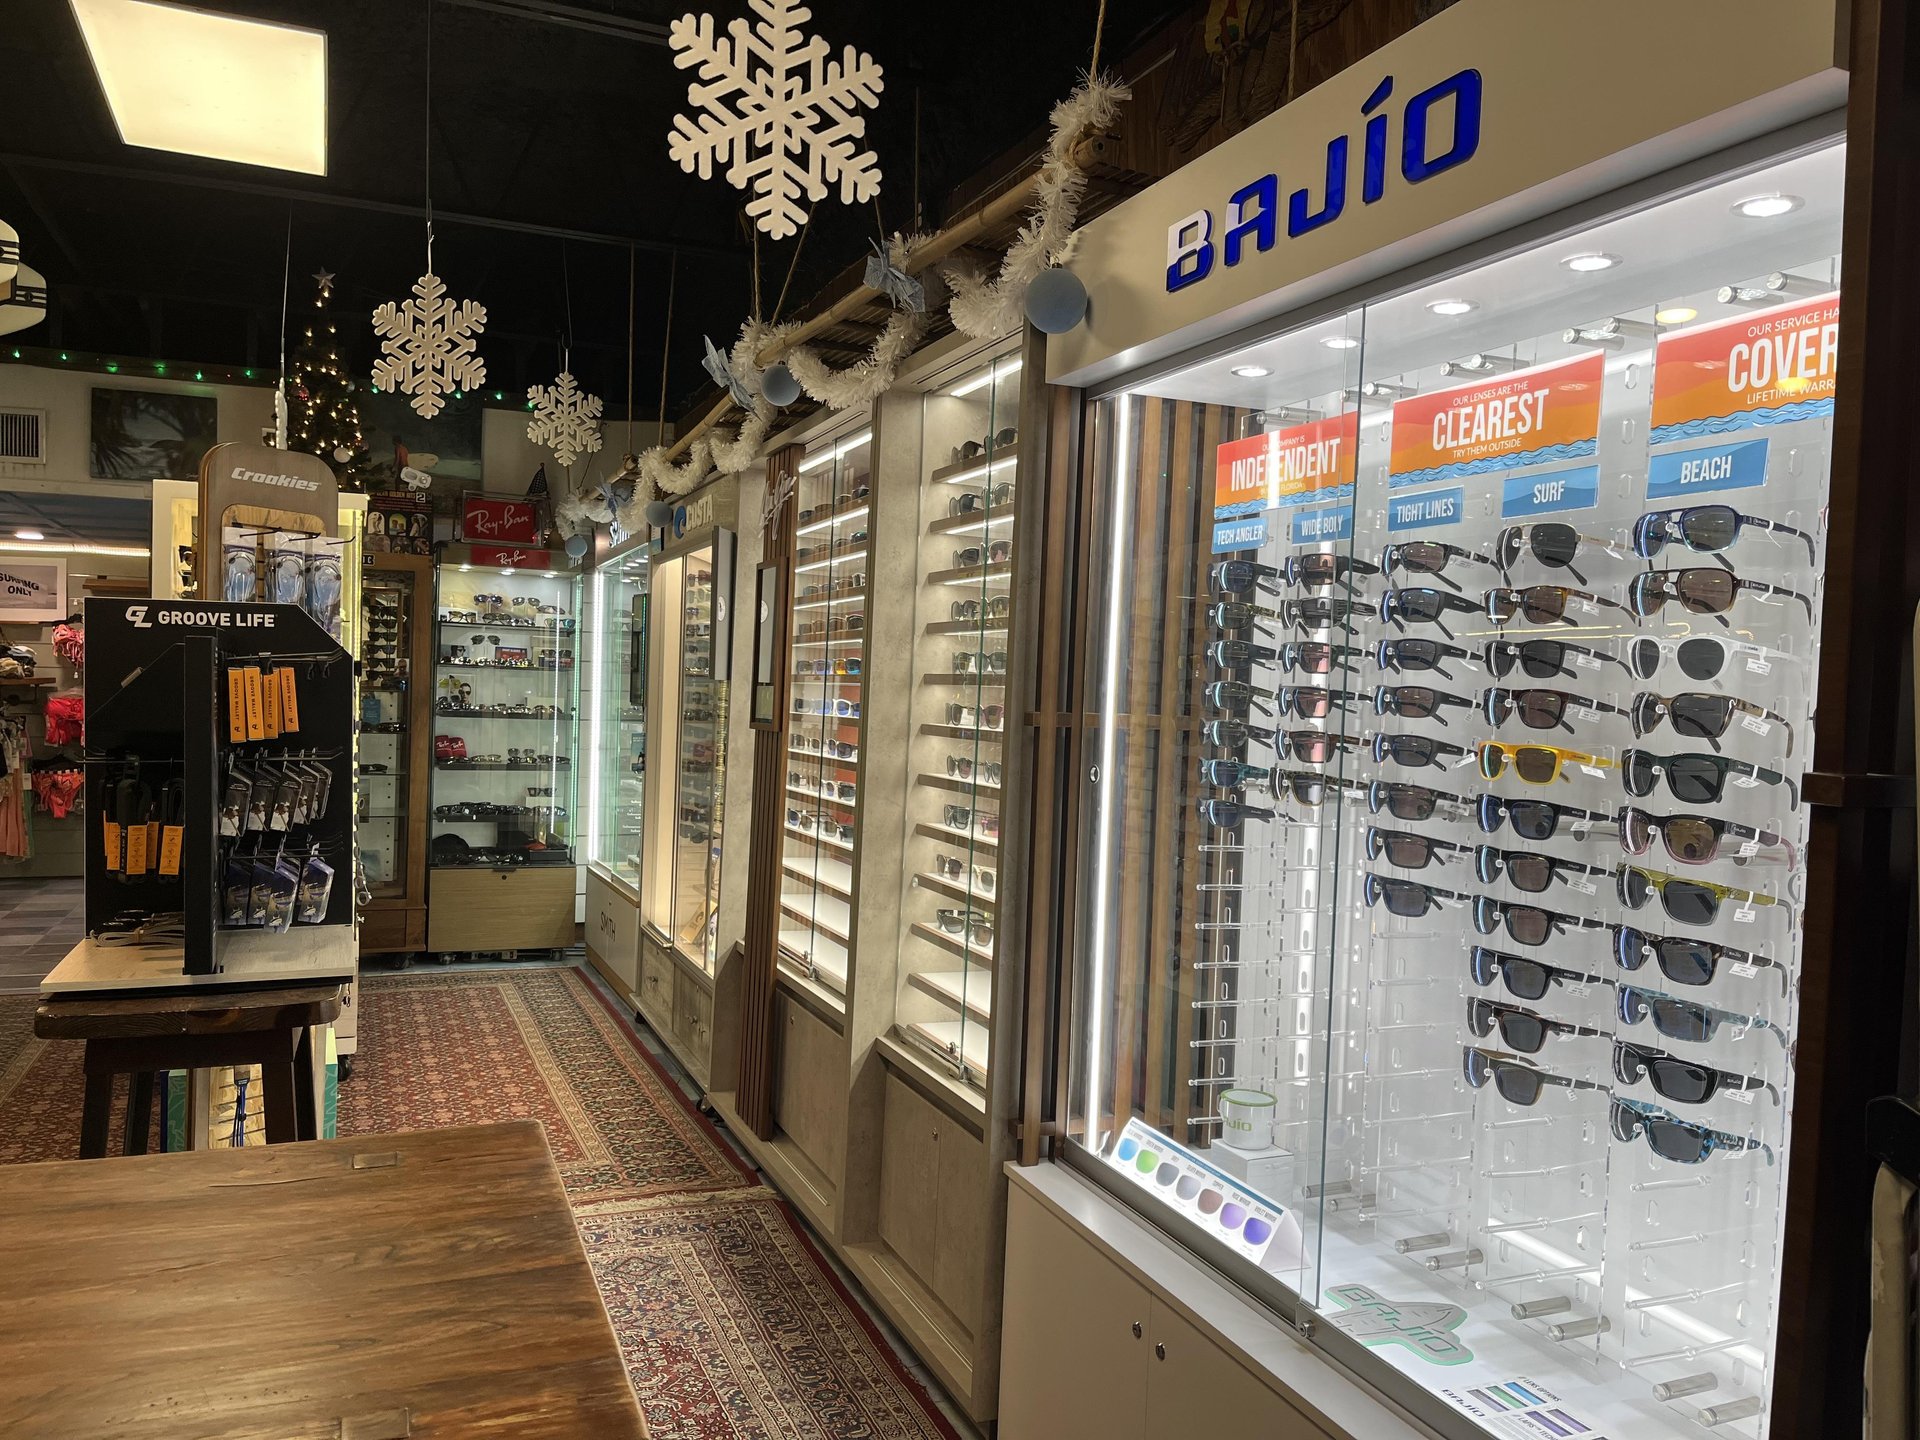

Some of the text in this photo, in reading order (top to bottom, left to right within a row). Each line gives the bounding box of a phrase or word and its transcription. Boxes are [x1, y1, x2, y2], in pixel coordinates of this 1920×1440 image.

[1166, 68, 1482, 292] BAJÍO
[1748, 324, 1772, 337] OUR
[1775, 312, 1820, 332] SERVICE
[1453, 381, 1529, 406] OUR LENSES ARE THE
[1747, 386, 1796, 404] LIFETIME
[1432, 388, 1550, 450] CLEAREST
[1274, 436, 1300, 449] OMPANY
[1453, 438, 1522, 458] TRY THEM OUTSIDE
[232, 468, 320, 491] Croakies
[1680, 455, 1732, 484] BEACH
[417, 493, 425, 502] 2
[1533, 480, 1566, 504] SURF
[467, 505, 529, 535] Ray-Ban
[686, 494, 714, 532] COSTA
[1396, 498, 1454, 523] TIGHT LINES
[1217, 525, 1263, 545] TECH ANGLER
[1302, 518, 1322, 536] WIDE
[496, 550, 526, 565] Ray-Ban
[8, 586, 32, 597] ONLY
[158, 610, 275, 628] GROOVE LIFE
[600, 911, 616, 942] SMITH
[1523, 1378, 1562, 1402] LENS OPTIONS
